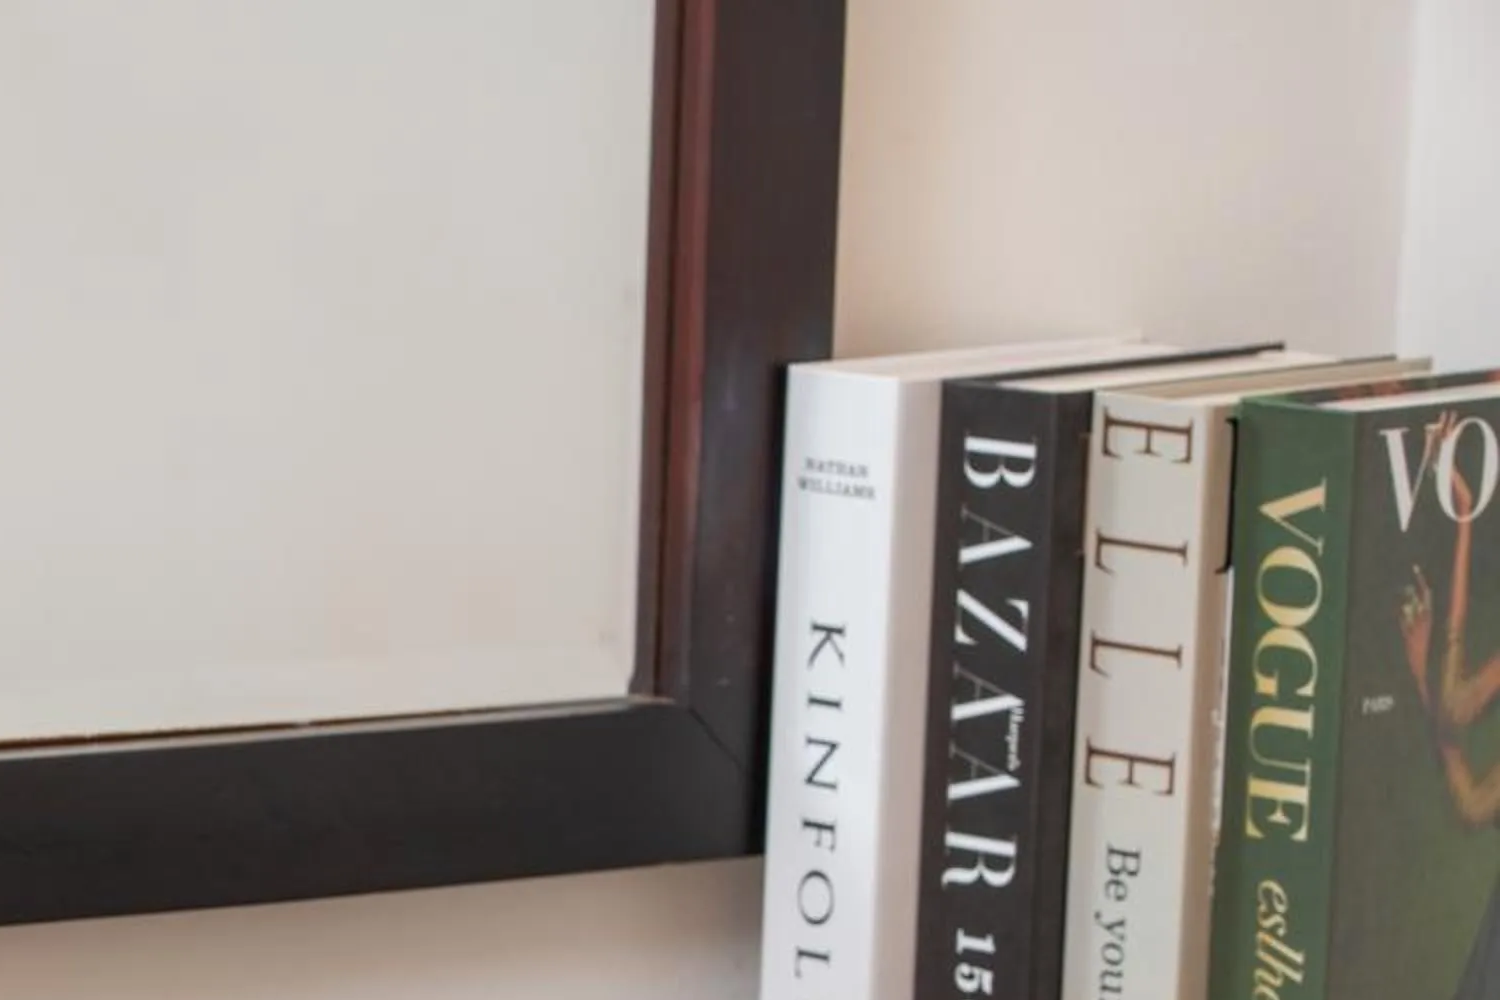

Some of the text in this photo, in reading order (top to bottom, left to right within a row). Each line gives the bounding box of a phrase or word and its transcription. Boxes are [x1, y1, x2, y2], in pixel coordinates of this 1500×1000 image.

[1086, 405, 1193, 796] ELLE
[1379, 416, 1499, 532] VO
[942, 434, 1038, 890] BAZAAR
[1245, 476, 1328, 842] VOGUE
[1103, 843, 1142, 903] Be
